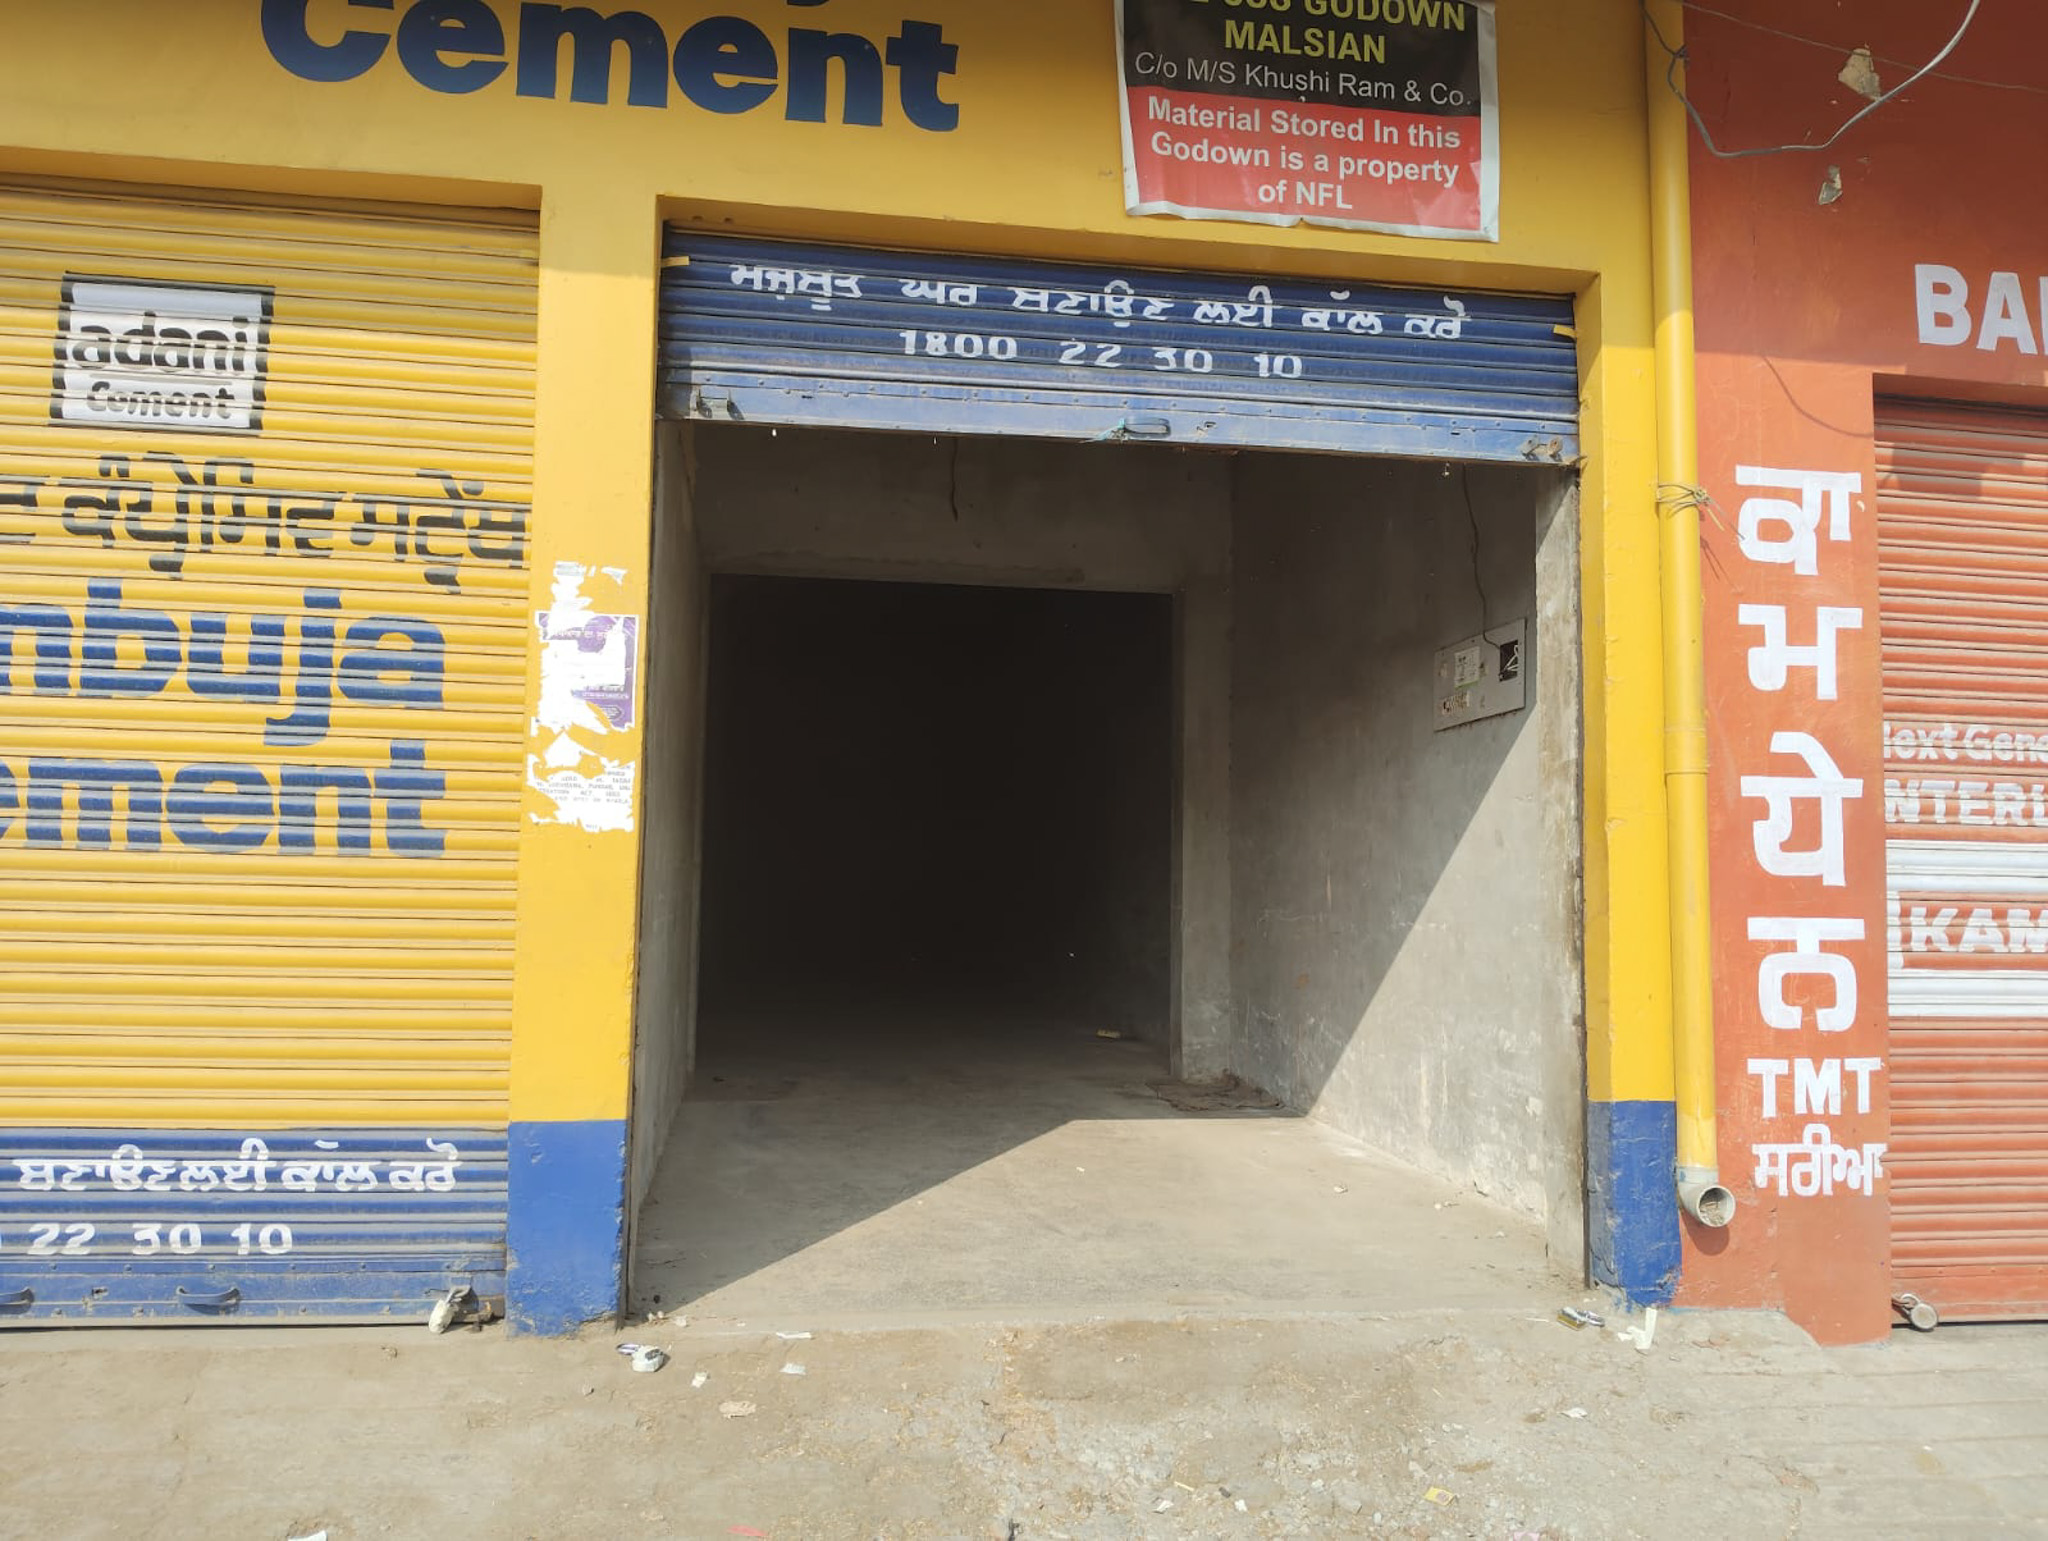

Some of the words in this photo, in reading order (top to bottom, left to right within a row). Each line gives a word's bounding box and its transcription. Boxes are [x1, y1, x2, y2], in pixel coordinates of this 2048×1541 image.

[262, 0, 959, 132] Cement
[1224, 20, 1386, 64] MALSIAN
[1134, 51, 1178, 79] C/o
[1187, 58, 1236, 84] M/S
[1245, 63, 1330, 94] Khushi
[1338, 73, 1396, 100] Ram
[1404, 80, 1422, 102] &
[1430, 82, 1472, 107] Co.
[1148, 95, 1261, 133] Material
[1270, 110, 1365, 143] Stored
[1374, 119, 1399, 145] In
[1408, 124, 1462, 149] this
[1151, 130, 1270, 168] Godown
[1280, 146, 1304, 171] is
[1313, 154, 1329, 173] a
[1339, 153, 1459, 189] property
[1257, 180, 1287, 204] of
[1296, 181, 1353, 210] NFL
[898, 279, 988, 306] ਘਰ
[1192, 285, 1284, 328] ਲਈ
[1914, 263, 2048, 356] BA
[72, 310, 249, 373] adani
[899, 329, 1018, 361] 1800
[1058, 340, 1123, 368] 22
[1151, 346, 1213, 373] 30
[1254, 351, 1303, 379] 10
[86, 380, 236, 420] Cement
[0, 738, 449, 860] ment
[1747, 1056, 1882, 1119] TMT
[27, 1222, 96, 1256] 22
[132, 1222, 202, 1256] 30
[231, 1222, 293, 1256] 10
